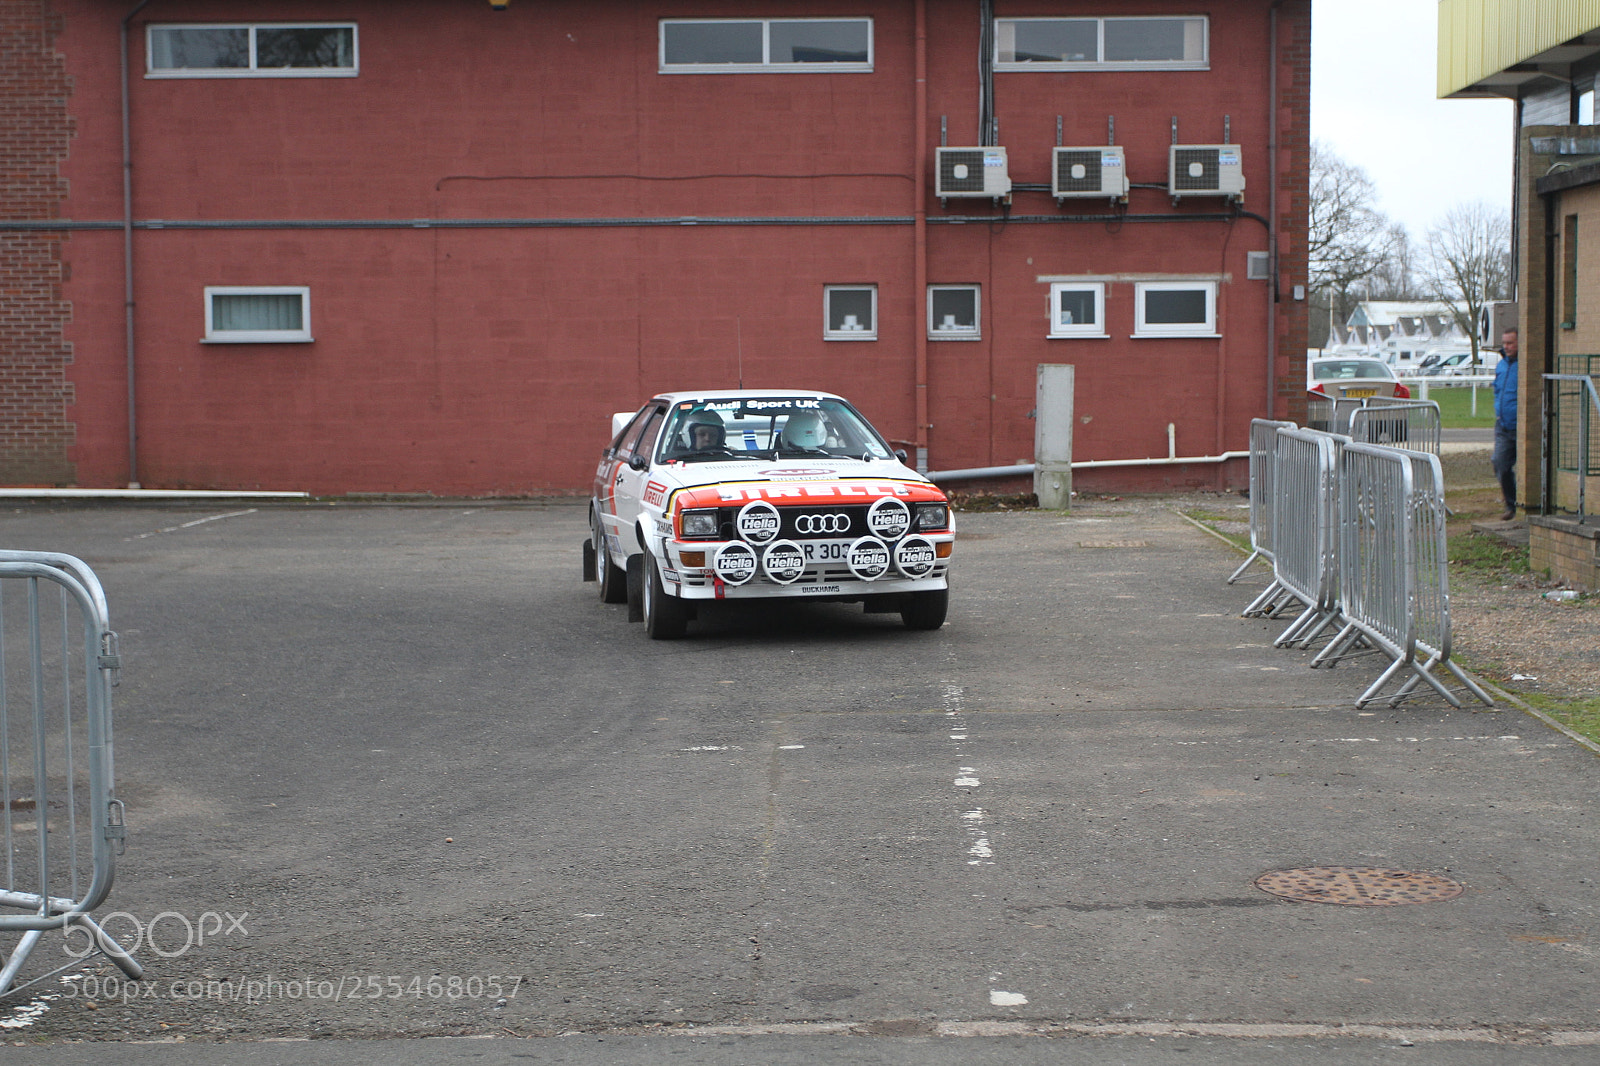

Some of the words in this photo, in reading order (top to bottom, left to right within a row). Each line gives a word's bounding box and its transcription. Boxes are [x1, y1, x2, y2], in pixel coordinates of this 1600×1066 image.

[703, 401, 741, 411] Audi
[746, 400, 792, 410] Sport
[795, 400, 820, 409] UK
[743, 518, 777, 530] Hella
[874, 514, 906, 526] Hella
[719, 557, 753, 569] Hella
[768, 557, 803, 569] Hella
[853, 553, 886, 565] Hella
[900, 552, 933, 564] Hella
